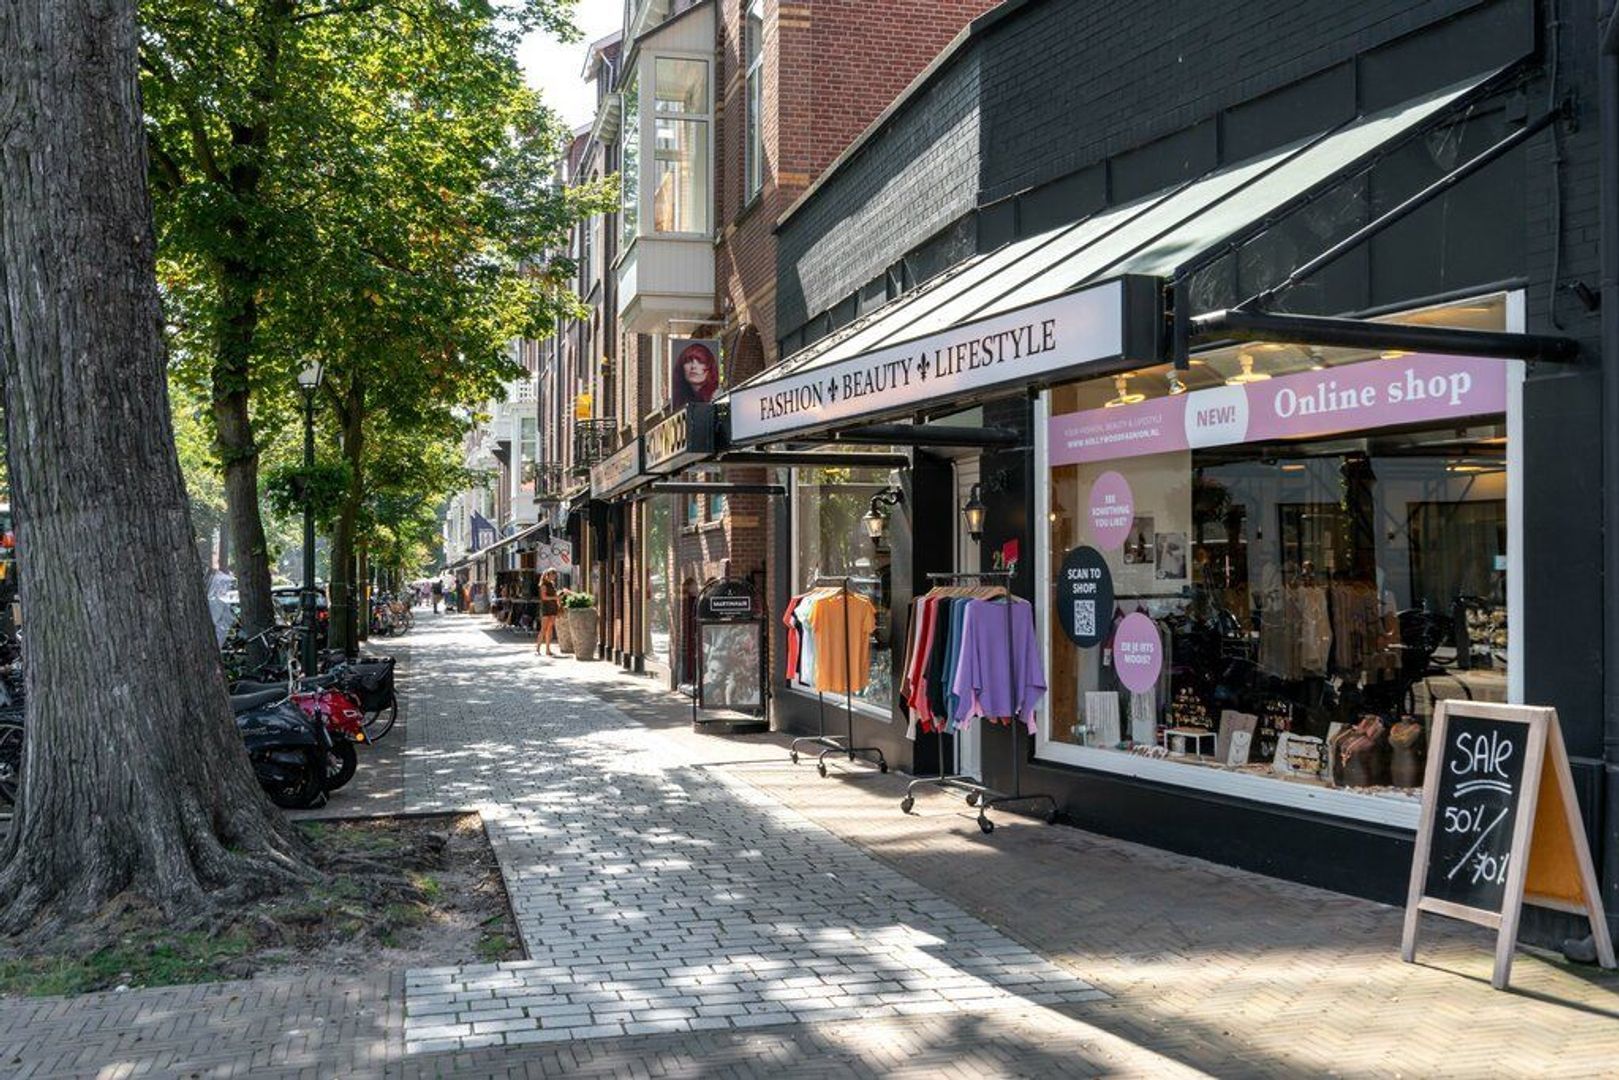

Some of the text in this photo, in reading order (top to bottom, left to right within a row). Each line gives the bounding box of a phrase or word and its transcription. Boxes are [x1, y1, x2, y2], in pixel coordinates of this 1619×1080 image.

[760, 319, 1056, 421] FASHION BEAUTY LIFESTYLE
[1274, 368, 1472, 418] Online shop
[1196, 406, 1236, 428] NEW!
[1067, 567, 1101, 580] SCAN TO
[1072, 582, 1097, 594] SHOP!
[1445, 804, 1485, 833] 50%
[1471, 851, 1510, 885] 70%
